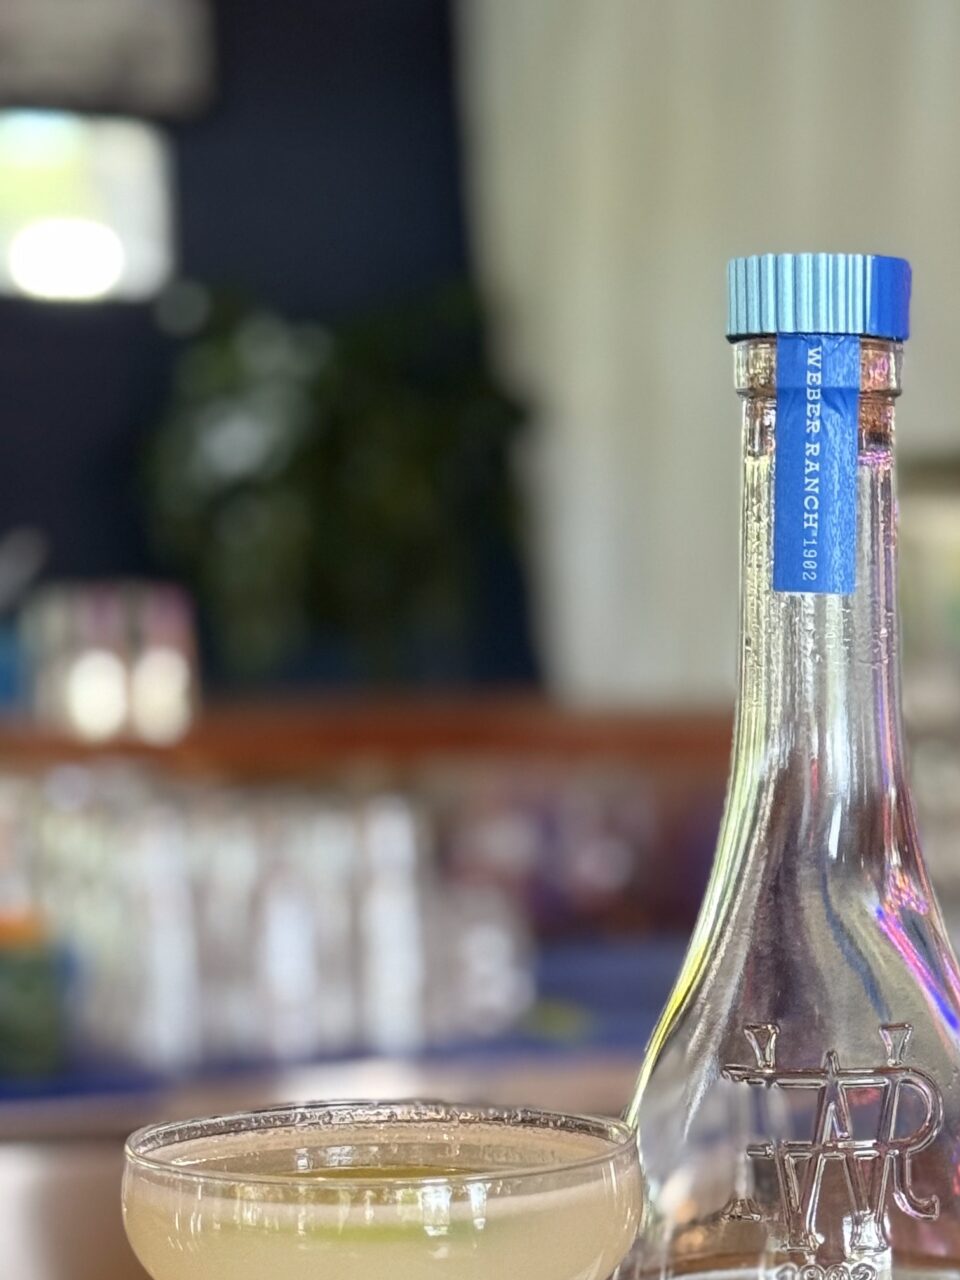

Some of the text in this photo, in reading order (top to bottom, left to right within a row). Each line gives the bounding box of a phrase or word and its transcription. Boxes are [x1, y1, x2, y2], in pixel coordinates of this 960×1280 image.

[802, 346, 822, 582] WEBER RANCH 1902
